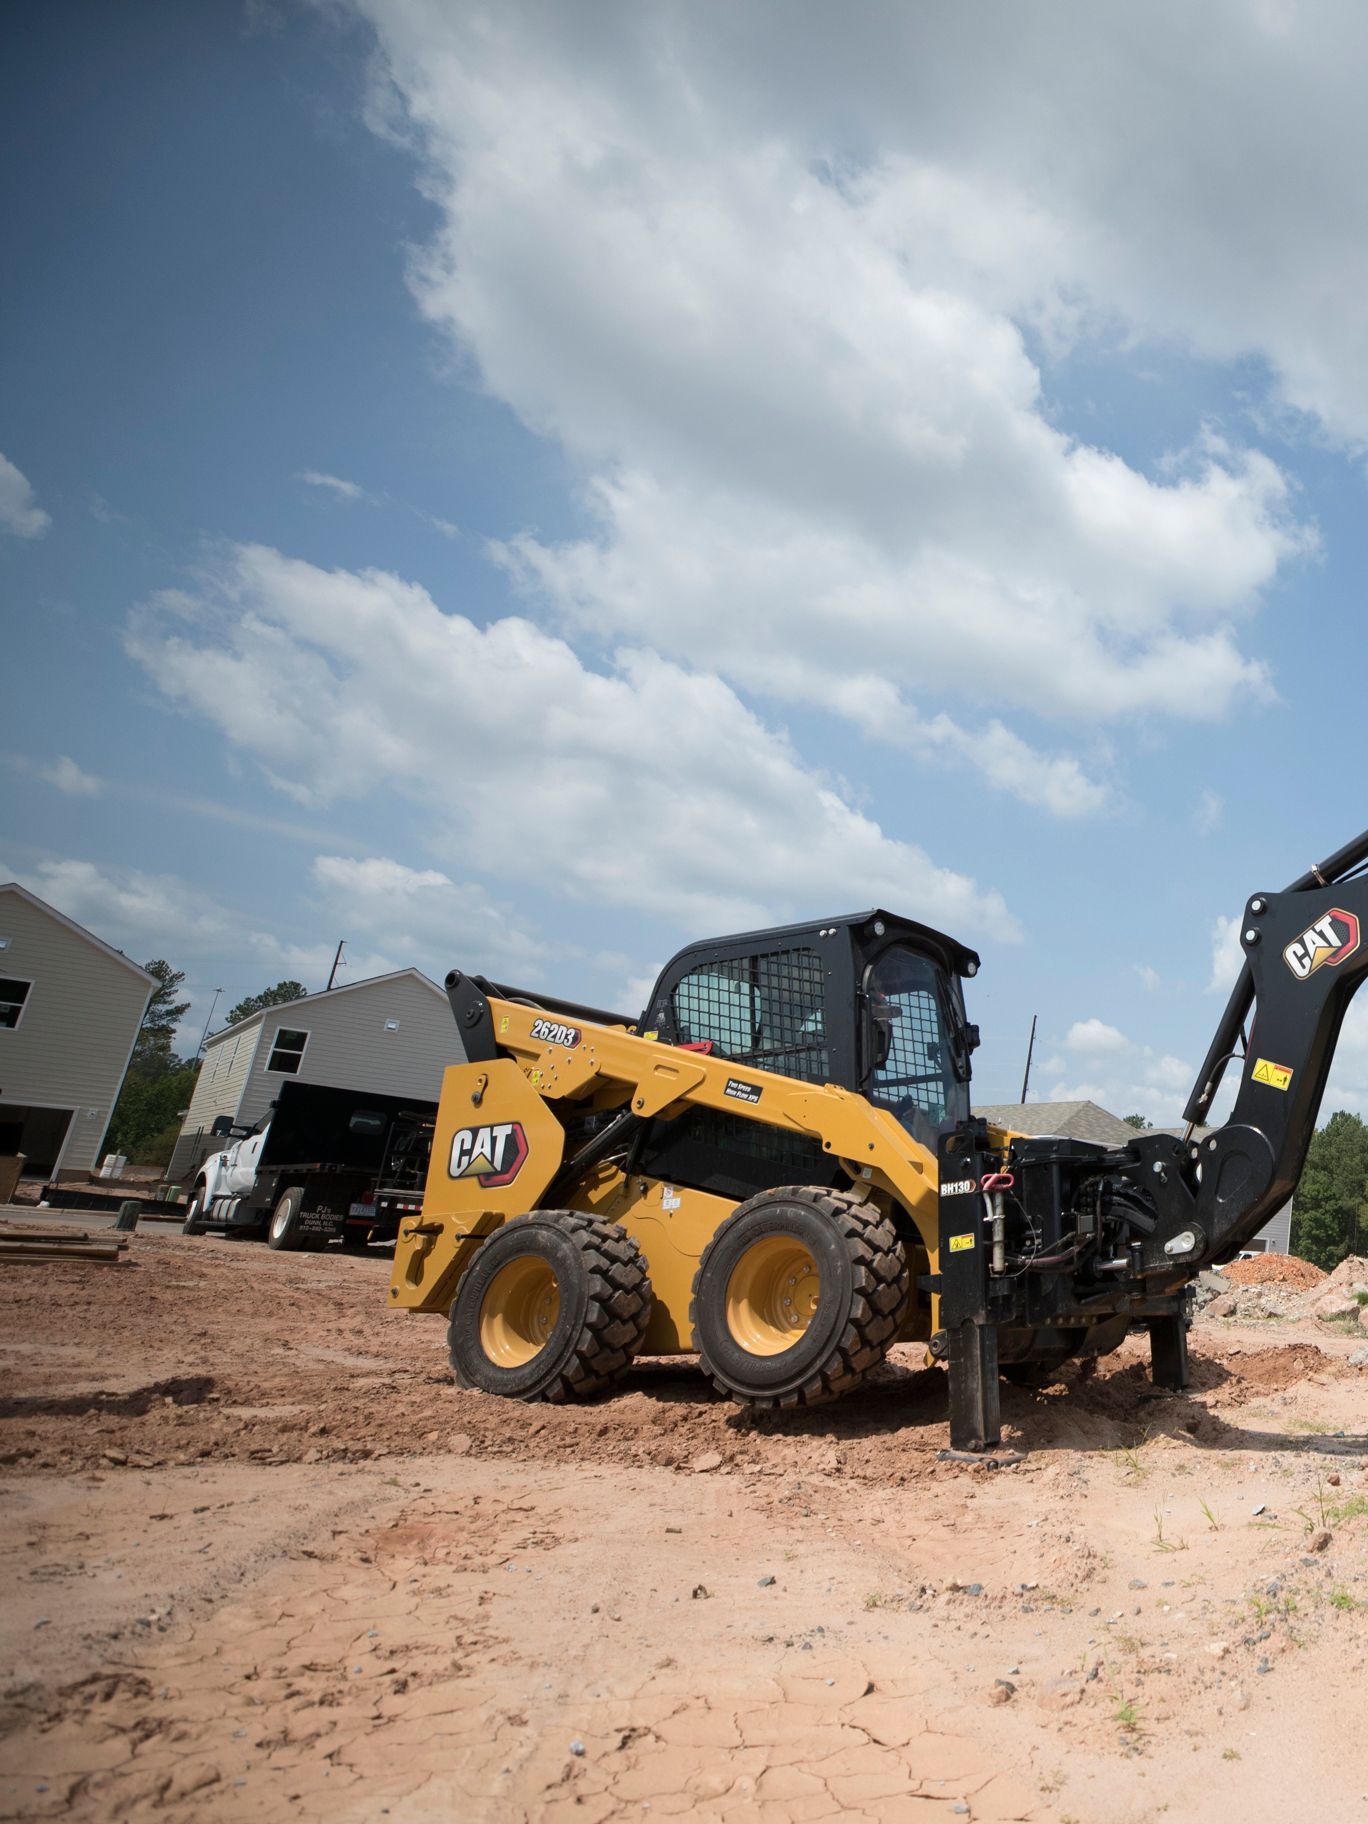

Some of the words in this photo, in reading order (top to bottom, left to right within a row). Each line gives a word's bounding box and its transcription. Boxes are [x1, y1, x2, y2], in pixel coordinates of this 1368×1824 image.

[1285, 914, 1342, 977] CAT
[531, 1019, 576, 1047] 262D3
[449, 1124, 513, 1177] CAT
[941, 1180, 971, 1197] BH130
[299, 1211, 321, 1220] TRUCK
[320, 1213, 344, 1222] BODIES
